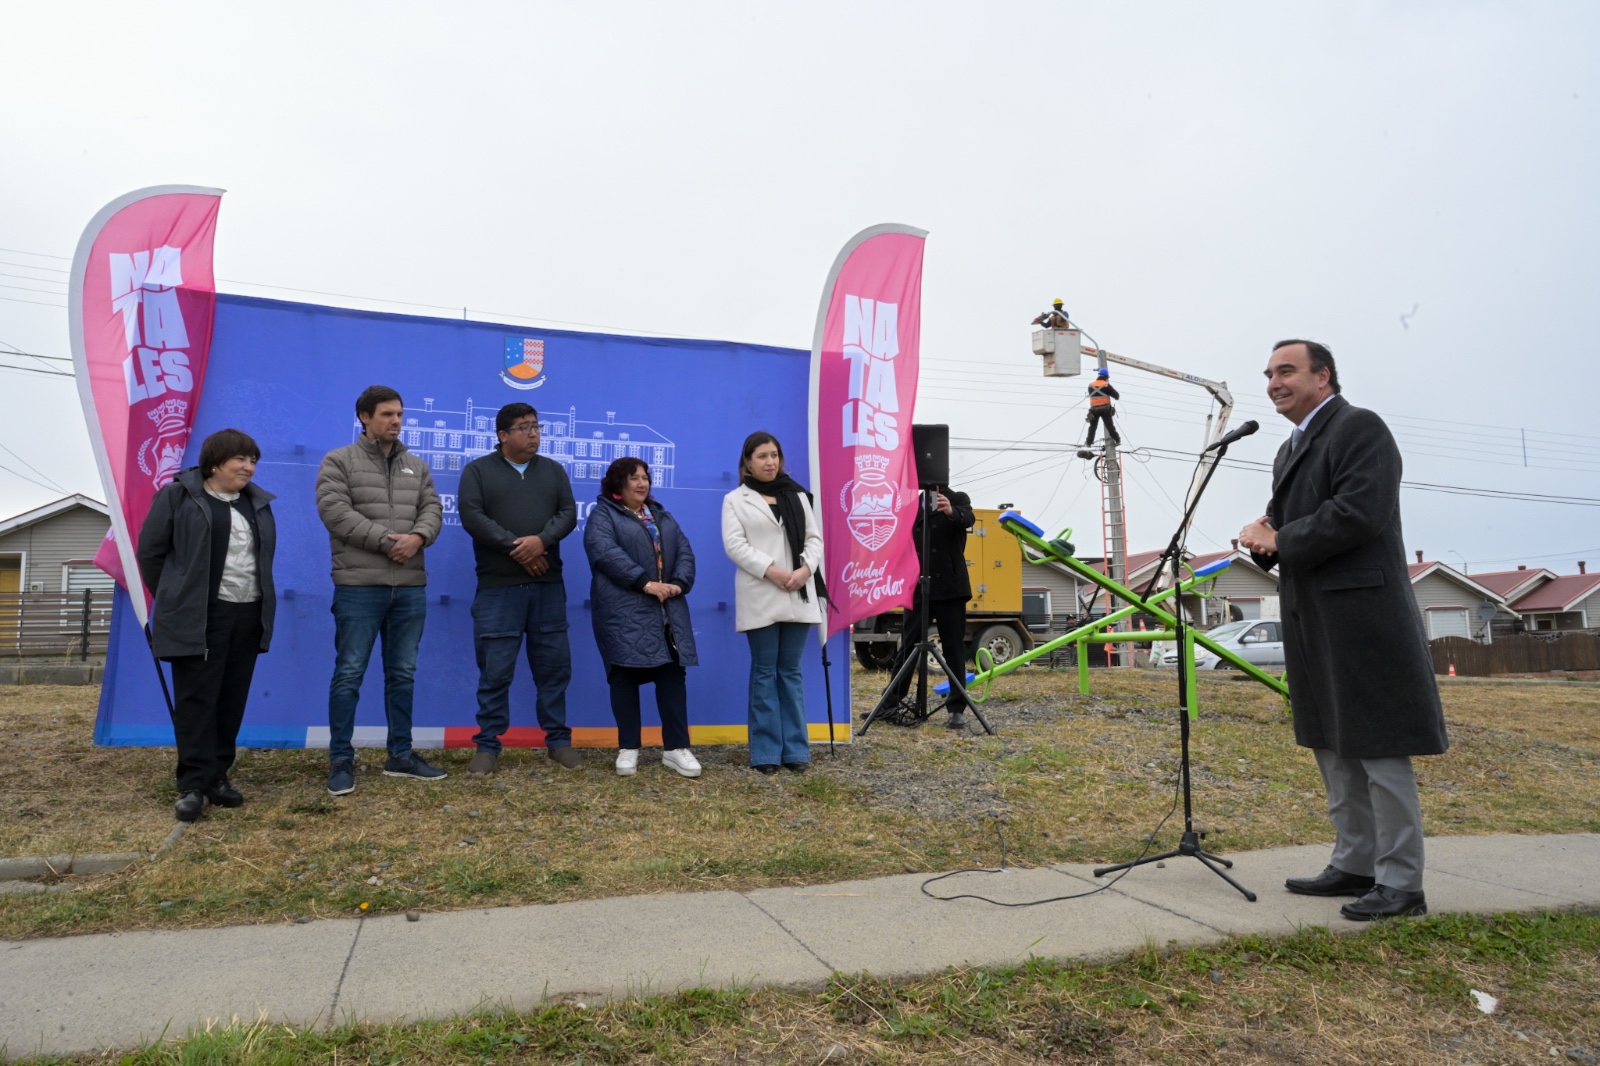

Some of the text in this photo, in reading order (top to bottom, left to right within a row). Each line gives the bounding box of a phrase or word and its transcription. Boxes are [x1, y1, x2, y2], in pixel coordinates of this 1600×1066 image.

[841, 559, 889, 583] Ciudad
[847, 574, 905, 605] Para Todos
